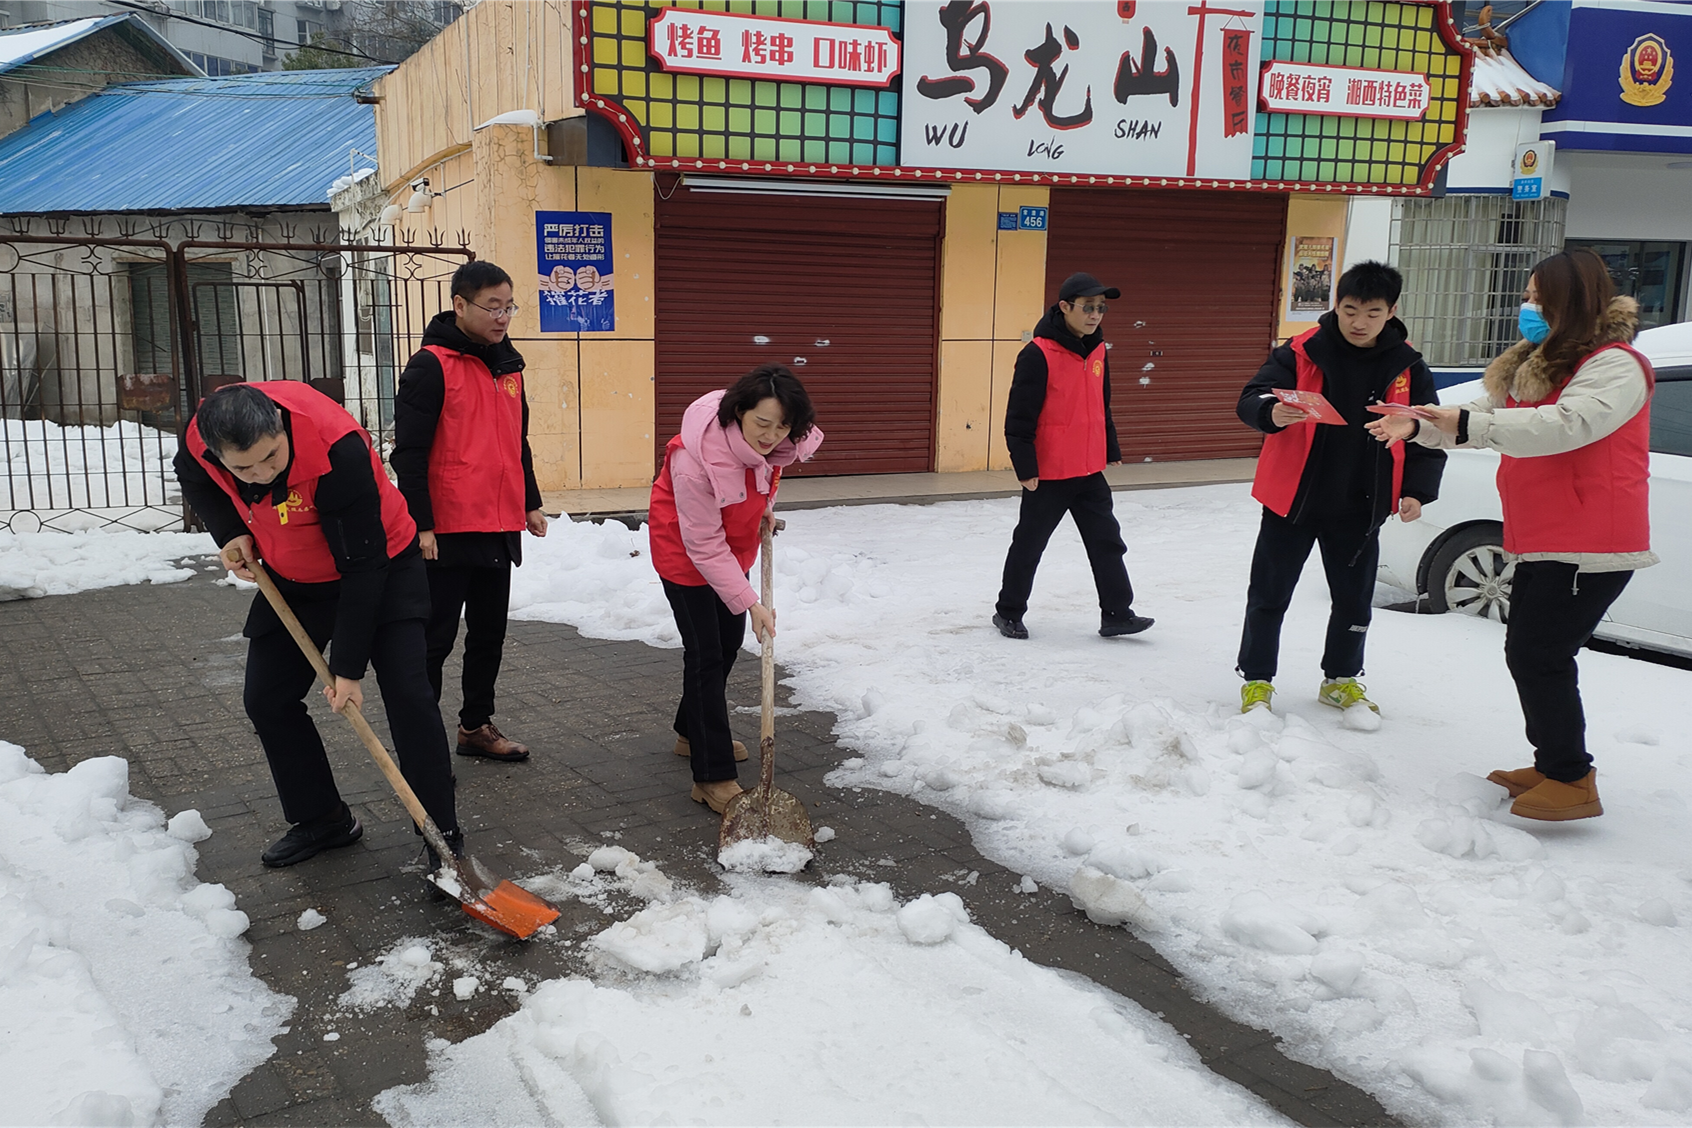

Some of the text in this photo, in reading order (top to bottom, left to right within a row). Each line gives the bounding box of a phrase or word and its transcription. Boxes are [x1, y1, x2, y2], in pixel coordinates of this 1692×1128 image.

[666, 22, 889, 74] 烤鱼 烤串 口味虾
[1268, 71, 1423, 110] 晚餐夜宵 湘西特色菜
[925, 120, 970, 149] WU
[1114, 118, 1162, 142] SHAN
[544, 223, 604, 236] 严厉打击
[1024, 216, 1042, 227] 456
[544, 244, 605, 253] 违法犯罪行为
